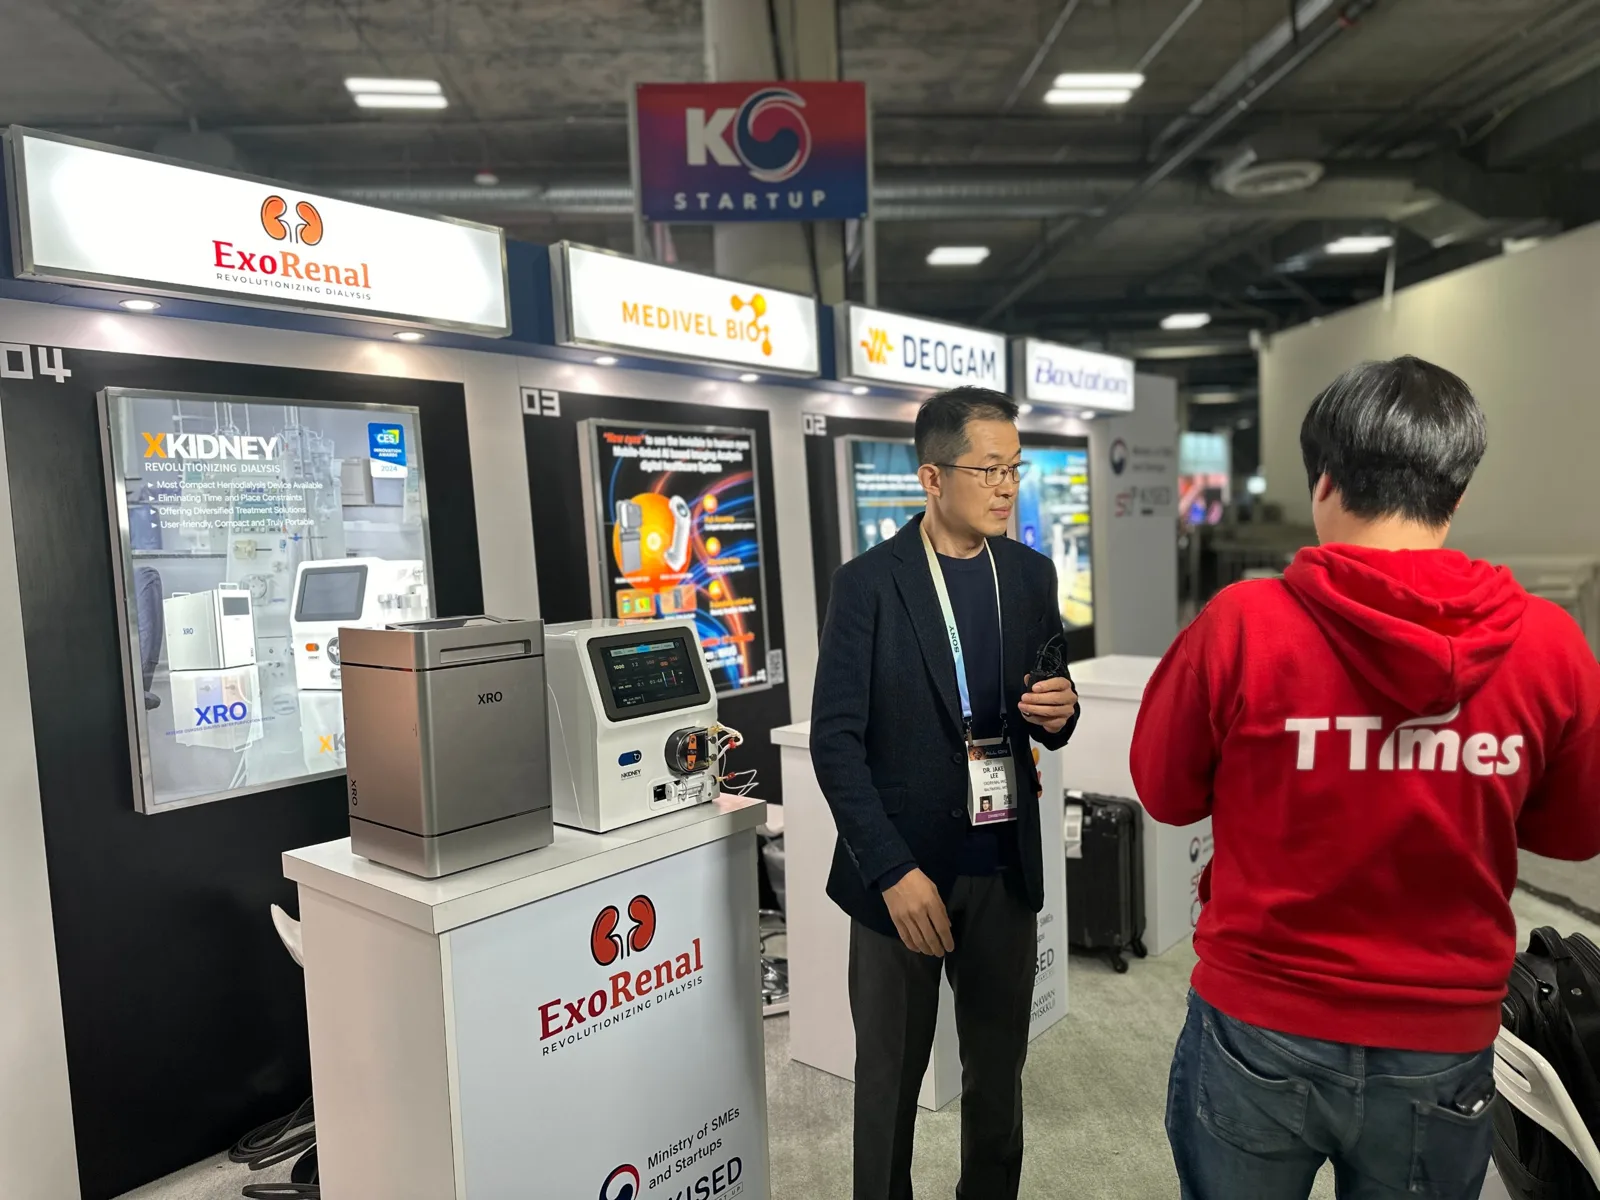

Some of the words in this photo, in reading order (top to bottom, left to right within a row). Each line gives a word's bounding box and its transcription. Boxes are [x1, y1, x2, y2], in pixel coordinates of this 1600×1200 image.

[674, 190, 826, 211] STARTUP
[212, 239, 372, 289] ExoRenal
[216, 273, 321, 294] REVOLUTIONIZING
[326, 288, 372, 300] DIALYSIS
[622, 301, 718, 338] MEDIVEL
[726, 318, 760, 342] BIO
[1, 343, 72, 384] 04
[902, 333, 997, 381] DEOGAM
[521, 387, 560, 417] 03
[802, 413, 827, 436] 02
[141, 432, 278, 461] XKIDNEY
[145, 462, 237, 473] REVOLUTIONIZING
[241, 464, 280, 473] DIALYSIS
[156, 481, 178, 489] Most
[179, 481, 215, 491] Compact
[216, 481, 266, 491] Hemodialysis
[267, 481, 291, 489] Device
[292, 481, 323, 489] Available
[158, 494, 201, 504] Eliminating
[201, 493, 222, 501] Time
[224, 493, 239, 501] and
[240, 493, 261, 501] Place
[262, 493, 303, 501] Constraints
[159, 507, 192, 517] Offering
[193, 506, 234, 515] Diversified
[235, 506, 273, 514] Treatment
[274, 506, 306, 514] Solutions
[214, 519, 250, 528] Compact
[251, 519, 266, 527] and
[267, 518, 283, 528] Truly
[285, 517, 315, 526] Portable
[949, 625, 960, 653] SONY
[478, 691, 503, 705] XRO
[194, 701, 248, 726] XRO
[537, 937, 704, 1041] ExoRenal
[542, 1000, 652, 1056] REVOLUTIONIZING
[656, 975, 704, 1004] DIALYSIS
[647, 1135, 694, 1170] Ministry
[696, 1122, 708, 1140] of
[712, 1107, 740, 1131] SMEs
[648, 1165, 672, 1189] and
[675, 1138, 723, 1174] Startups
[668, 1156, 742, 1200] ISED
